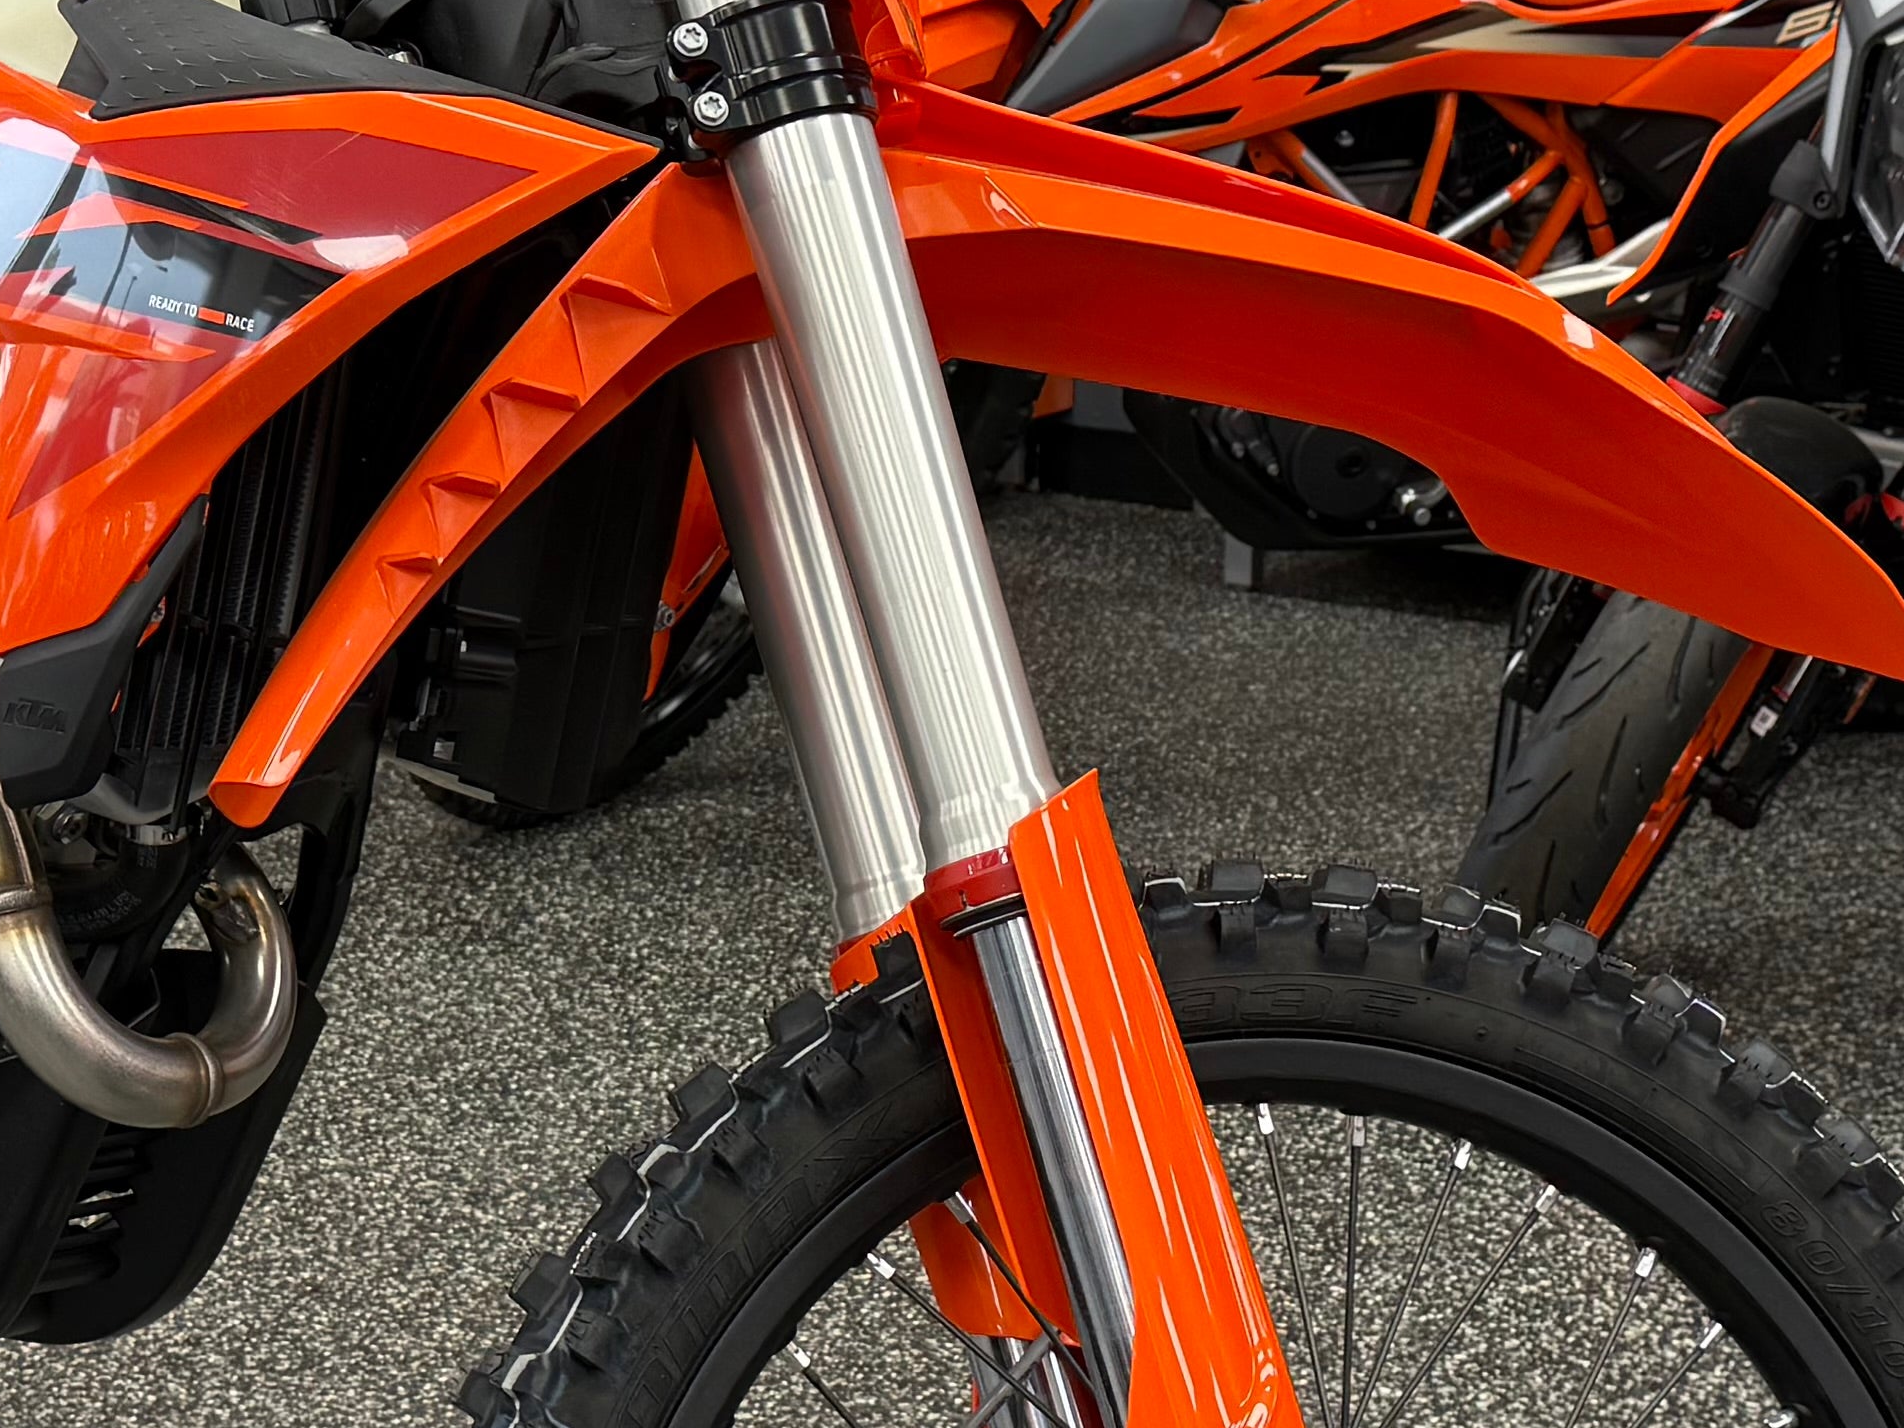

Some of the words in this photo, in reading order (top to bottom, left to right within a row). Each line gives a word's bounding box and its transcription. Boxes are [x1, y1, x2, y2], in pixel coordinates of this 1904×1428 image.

[148, 294, 184, 315] READY
[184, 302, 198, 318] TO
[225, 313, 256, 333] RACE
[2, 697, 66, 735] KTM
